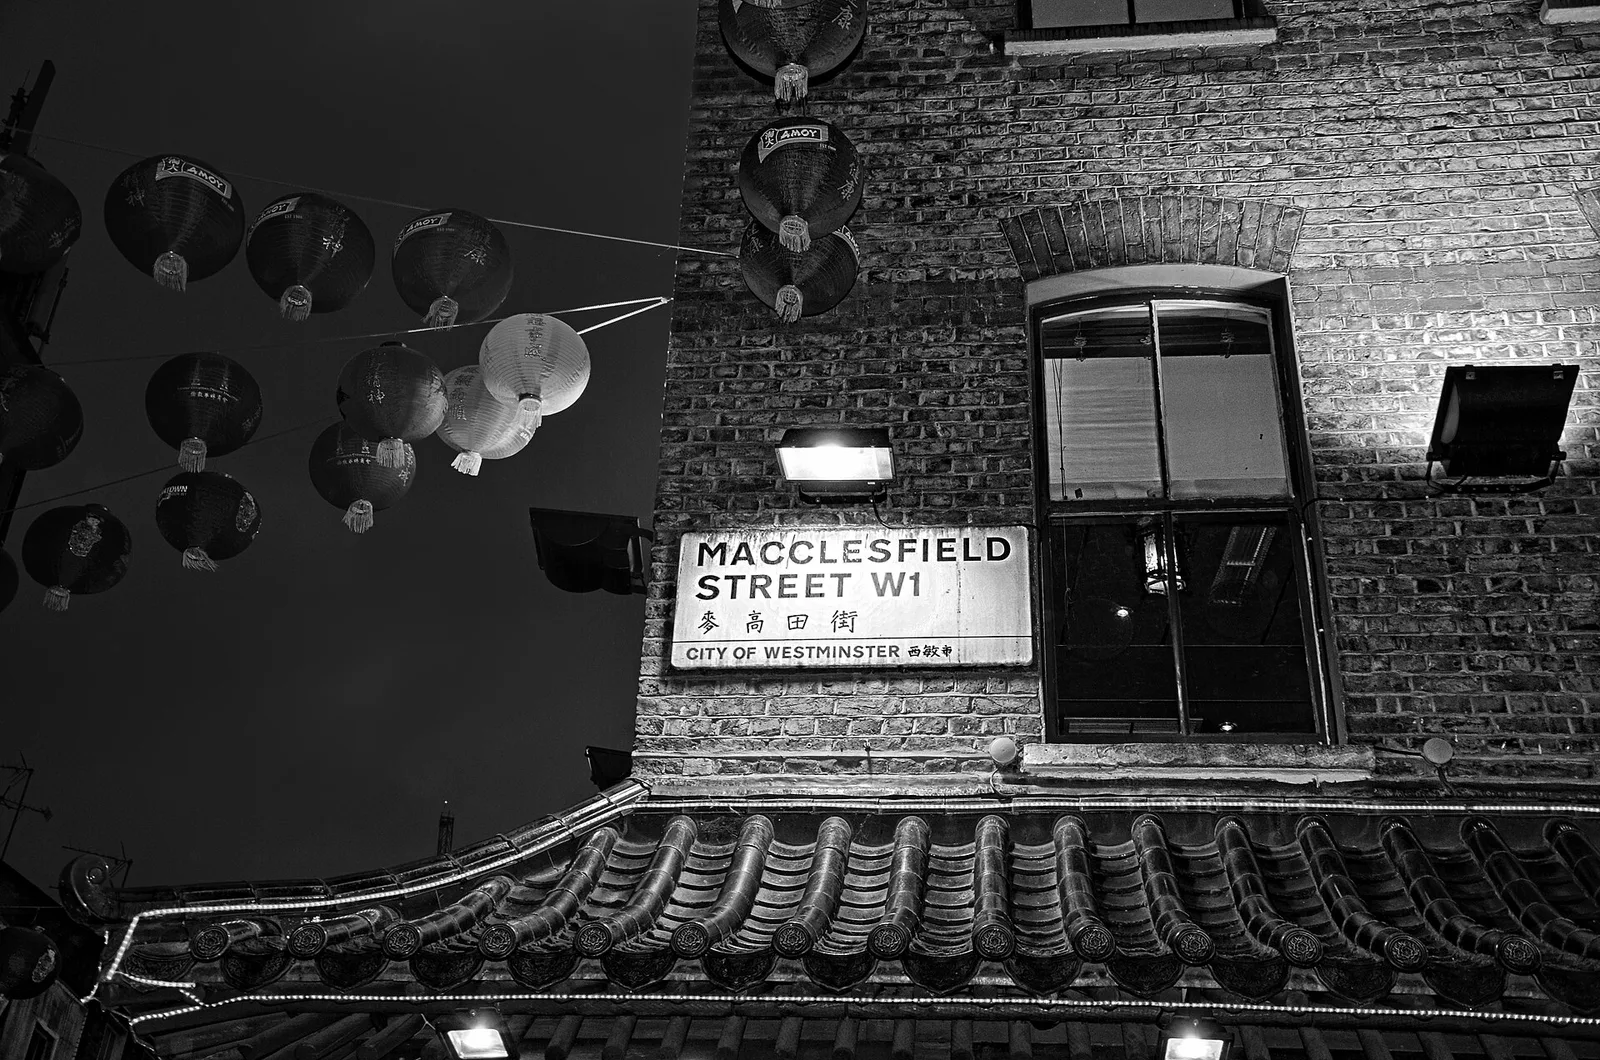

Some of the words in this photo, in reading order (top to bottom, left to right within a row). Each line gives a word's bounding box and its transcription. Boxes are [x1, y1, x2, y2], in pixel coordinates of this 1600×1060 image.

[780, 128, 817, 140] AMOY
[187, 166, 223, 189] AMOY
[406, 217, 438, 233] AMOY
[697, 537, 1011, 567] MACCLESFIELD
[695, 572, 852, 600] STREET
[870, 571, 920, 597] W1
[698, 610, 858, 635] 麥高田街
[686, 647, 727, 661] CITY
[733, 646, 757, 660] OF
[763, 644, 900, 659] WESTMINSTER
[908, 644, 952, 658] 西敏市
